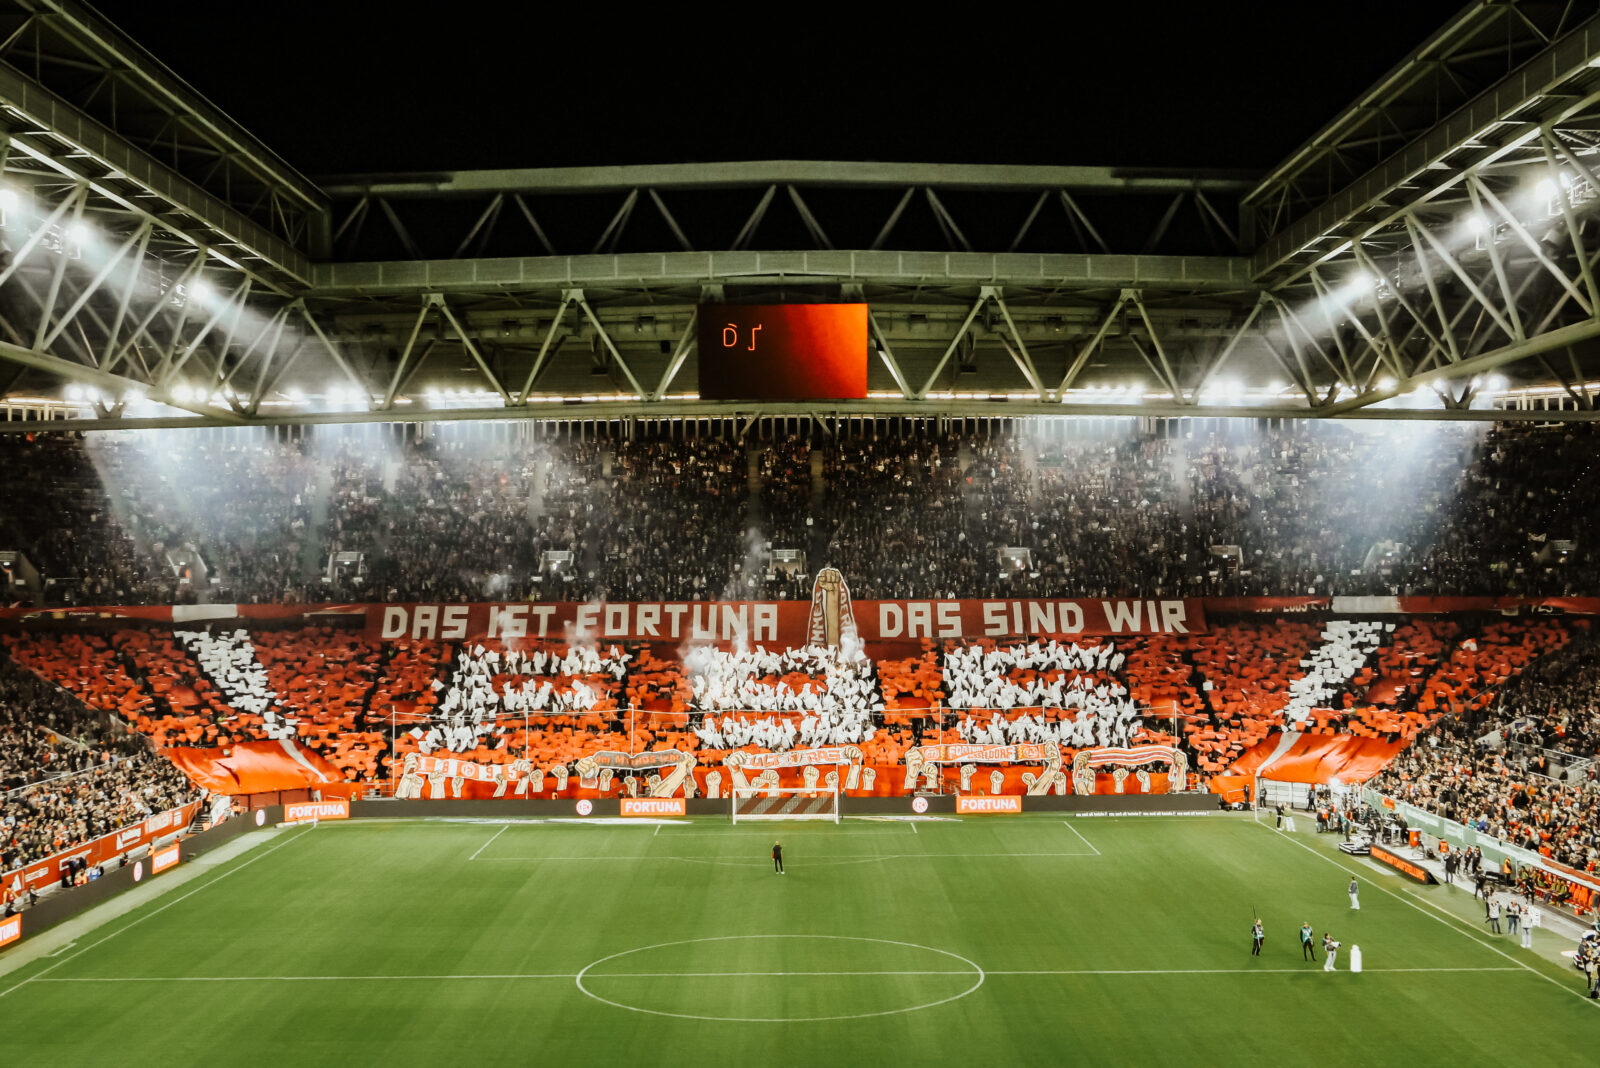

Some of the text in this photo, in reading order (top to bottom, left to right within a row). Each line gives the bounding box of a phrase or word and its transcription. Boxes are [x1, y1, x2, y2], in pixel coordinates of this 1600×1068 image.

[381, 604, 778, 641] DAS IST FORTUNA
[879, 600, 1190, 638] DAS SIND WIR
[288, 804, 345, 818] FORTUNA
[625, 801, 682, 812] FORTUNA
[961, 799, 1018, 810] FORTUNA
